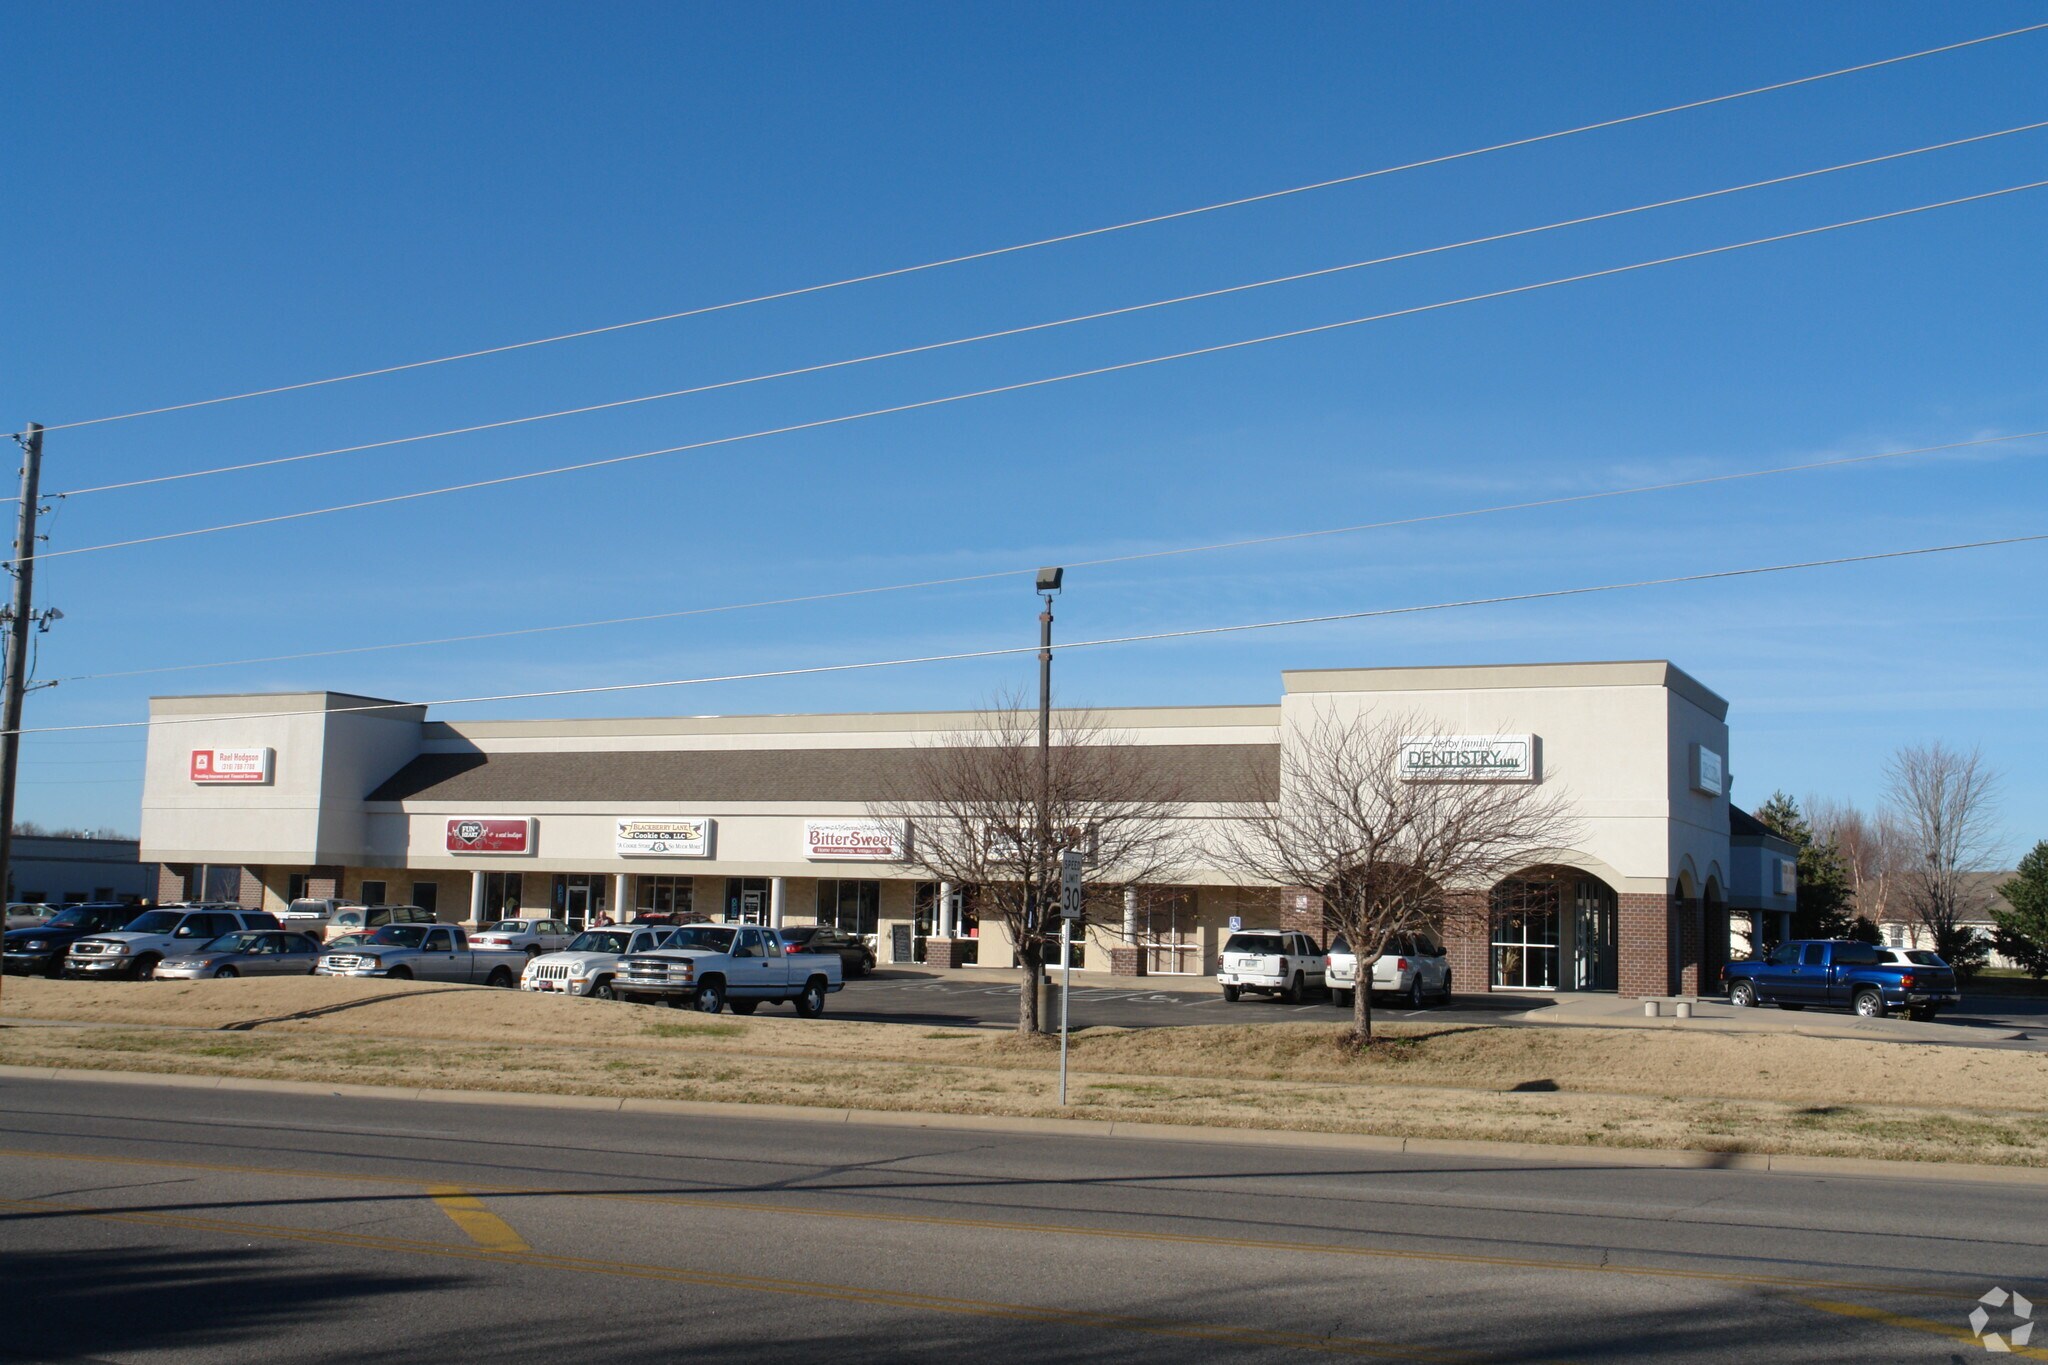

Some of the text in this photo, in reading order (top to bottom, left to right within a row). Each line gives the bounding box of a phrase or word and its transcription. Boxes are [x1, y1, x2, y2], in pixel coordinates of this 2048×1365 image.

[1460, 737, 1492, 748] family
[219, 753, 259, 763] Rael Hodgson
[1409, 750, 1501, 766] DENTISTRY
[461, 825, 475, 833] FUN
[808, 830, 894, 846] BitterSweet
[1064, 860, 1080, 871] SPEED
[1065, 873, 1079, 883] LIMIT
[1063, 886, 1080, 911] 30
